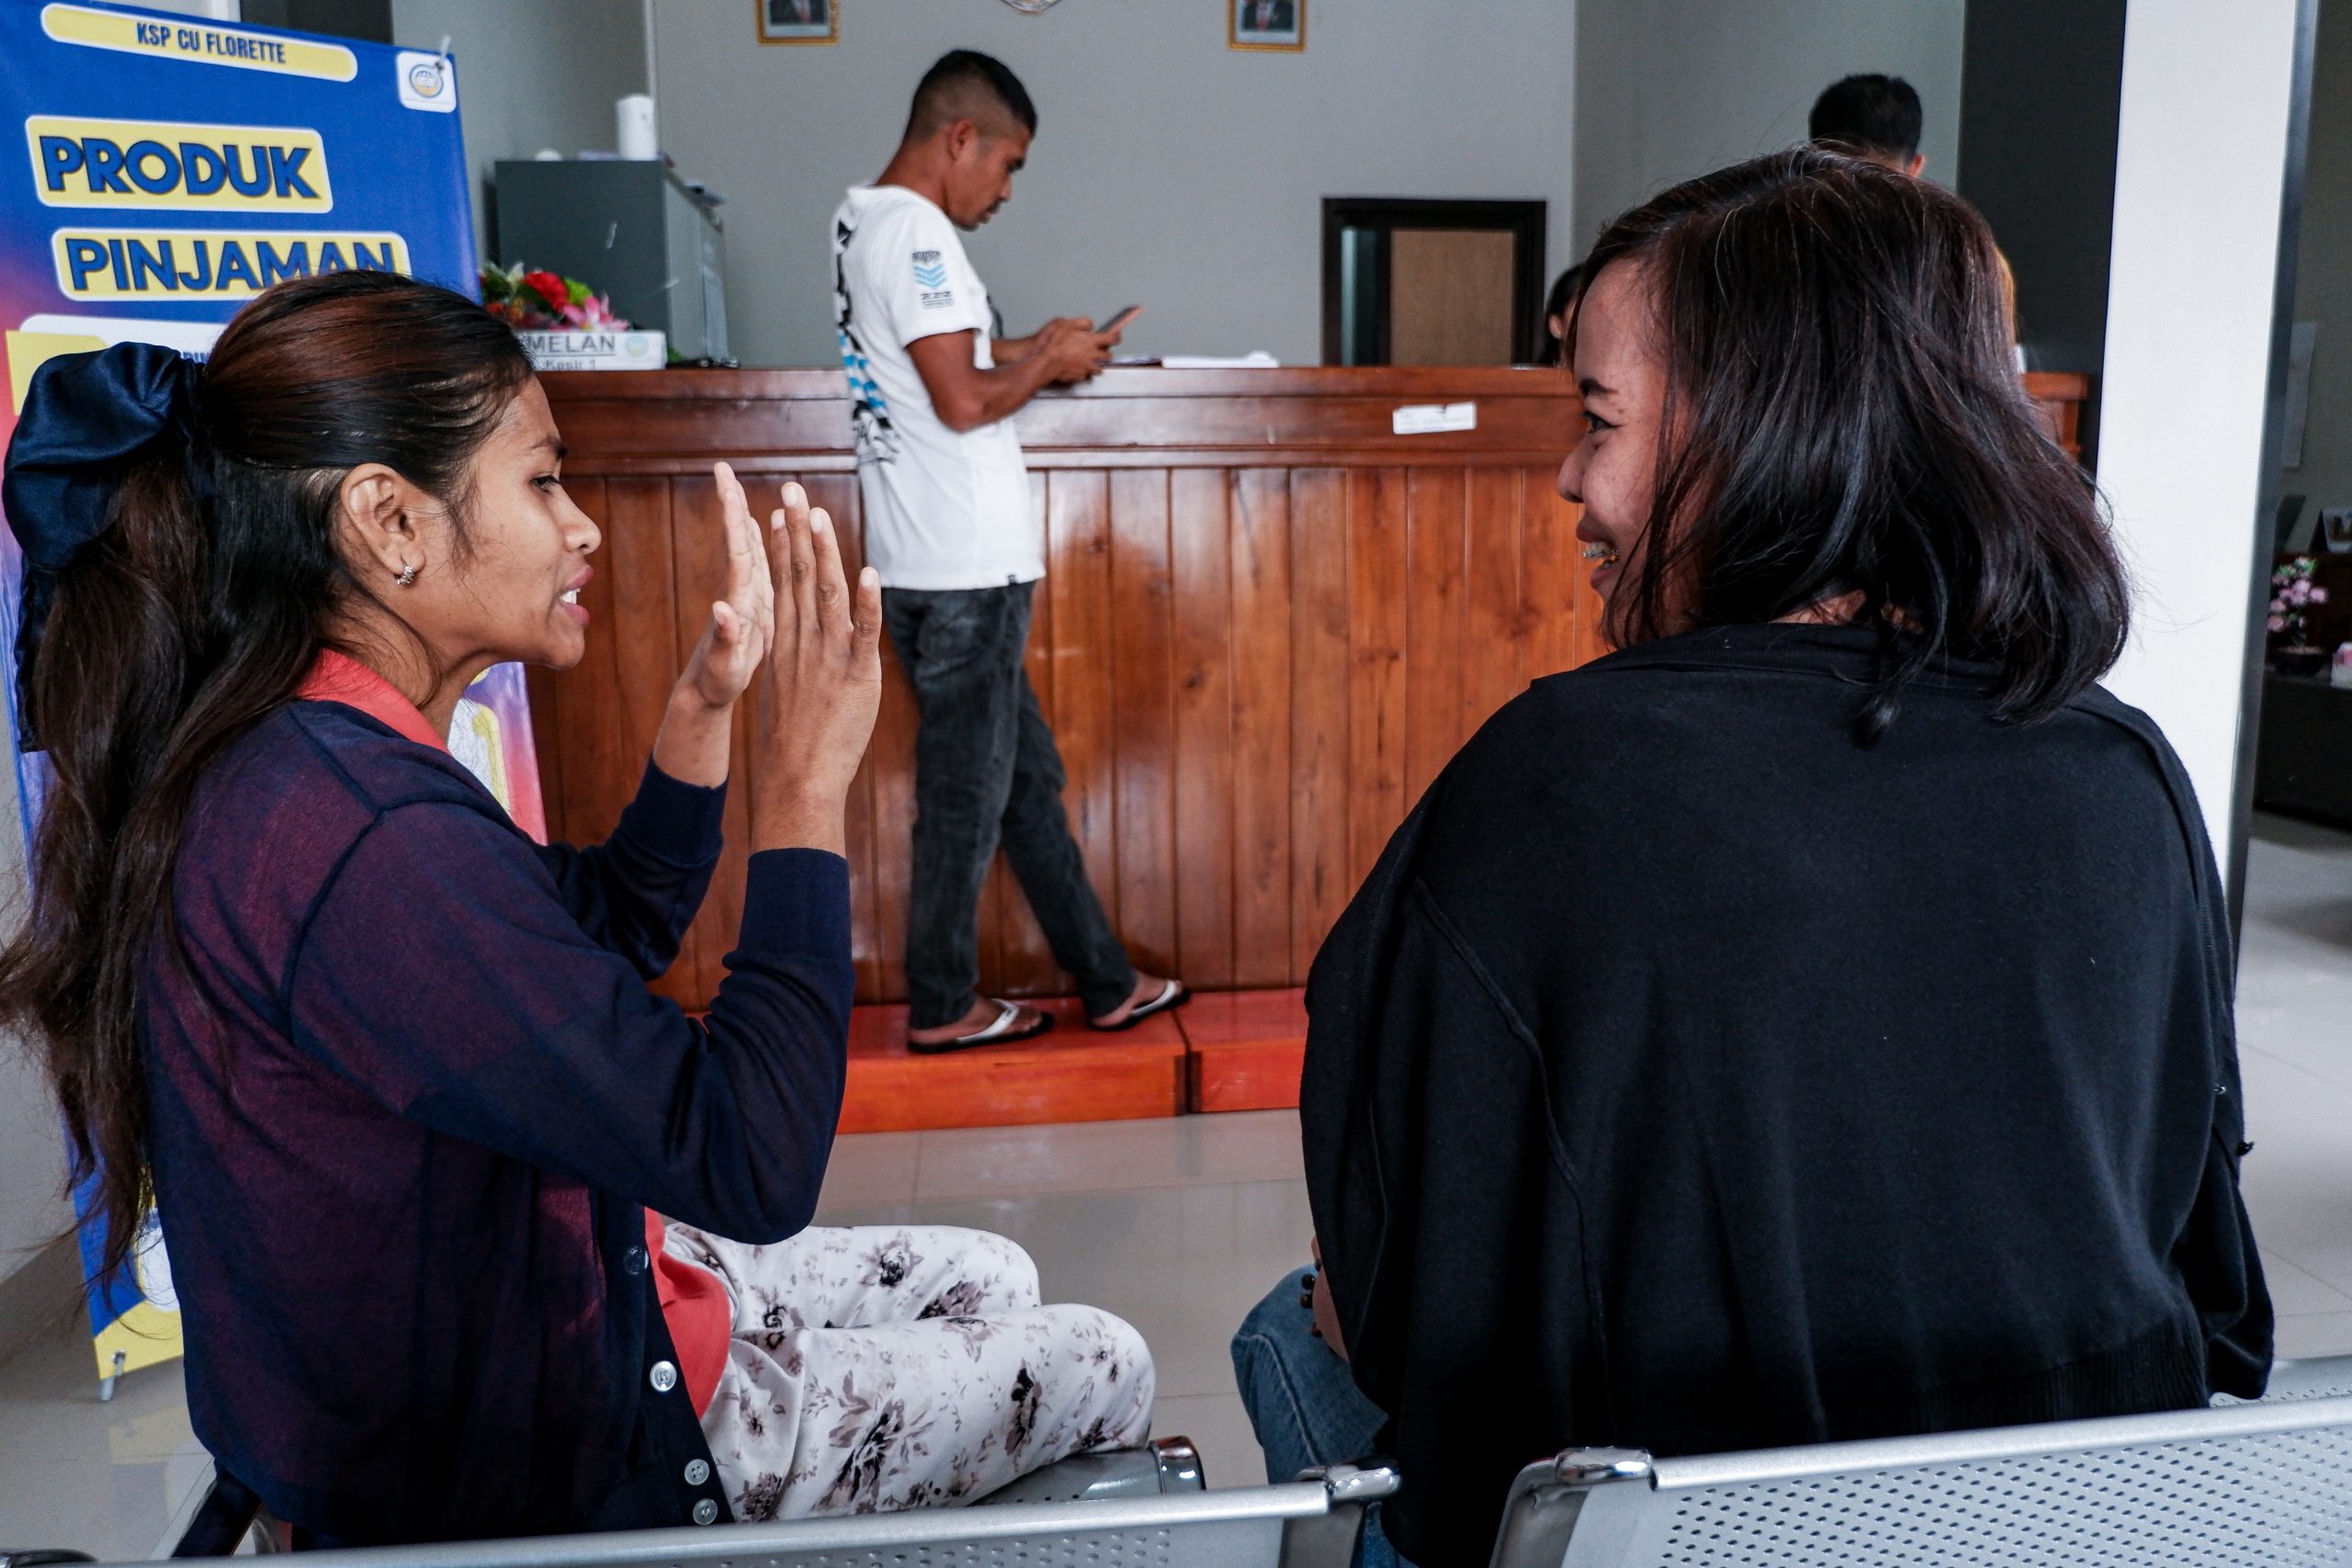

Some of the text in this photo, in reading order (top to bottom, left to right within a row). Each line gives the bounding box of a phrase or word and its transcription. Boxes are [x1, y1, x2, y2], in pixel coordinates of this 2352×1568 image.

[137, 23, 286, 63] KSP CU FLORETTE
[39, 135, 320, 199] PRODUK
